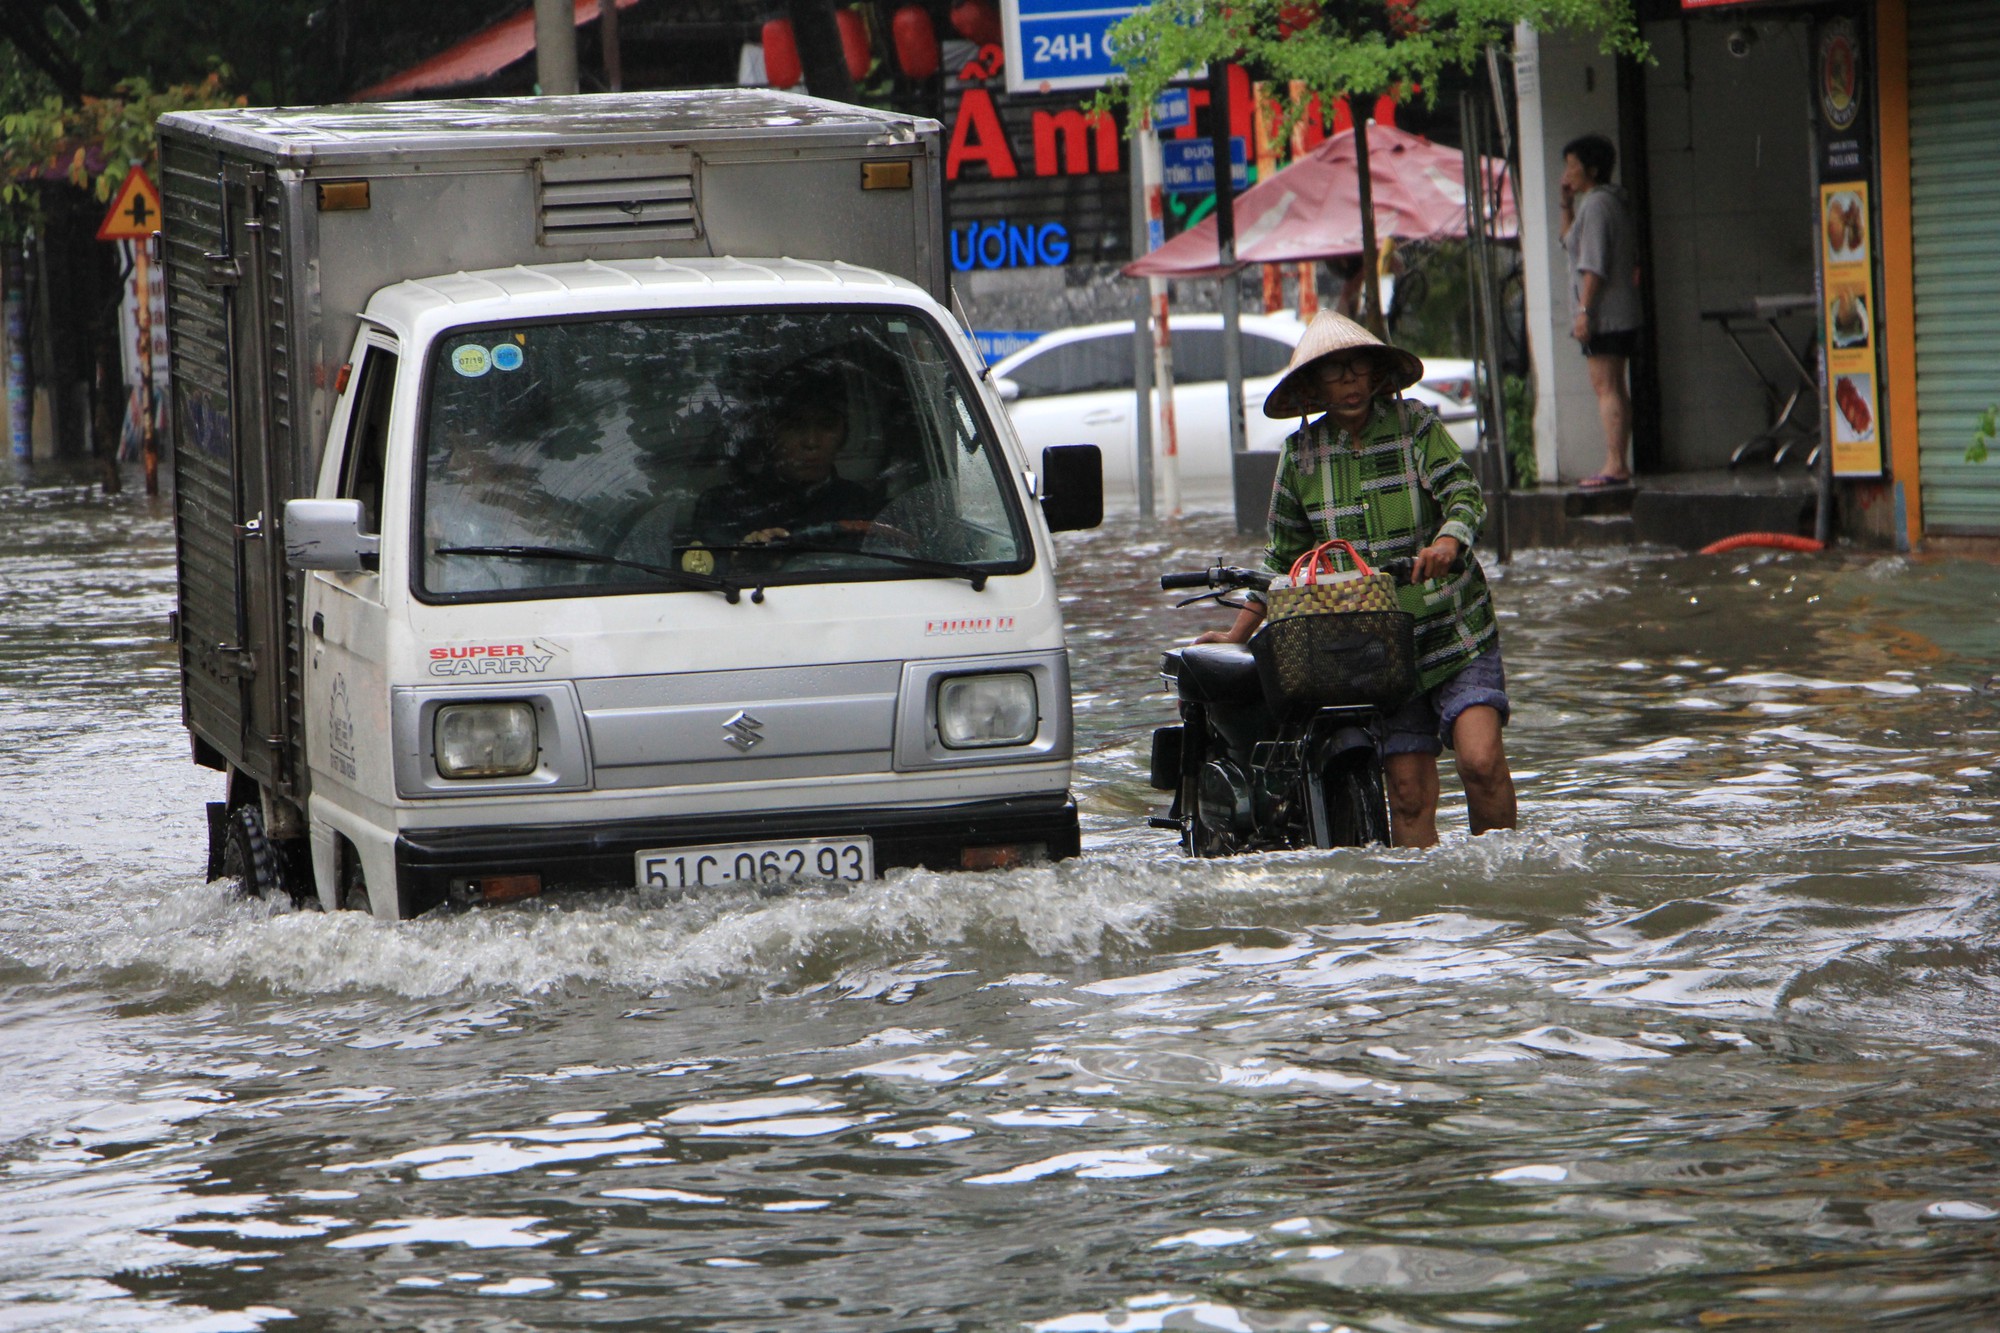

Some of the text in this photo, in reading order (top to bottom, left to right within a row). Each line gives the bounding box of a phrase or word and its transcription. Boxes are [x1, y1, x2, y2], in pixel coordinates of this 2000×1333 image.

[1032, 32, 1093, 63] 24H
[945, 43, 1120, 181] Ẩm
[951, 219, 1071, 272] ƯƠNG
[459, 357, 483, 365] 07/19
[429, 644, 525, 659] SUPER
[429, 656, 553, 676] CARRY
